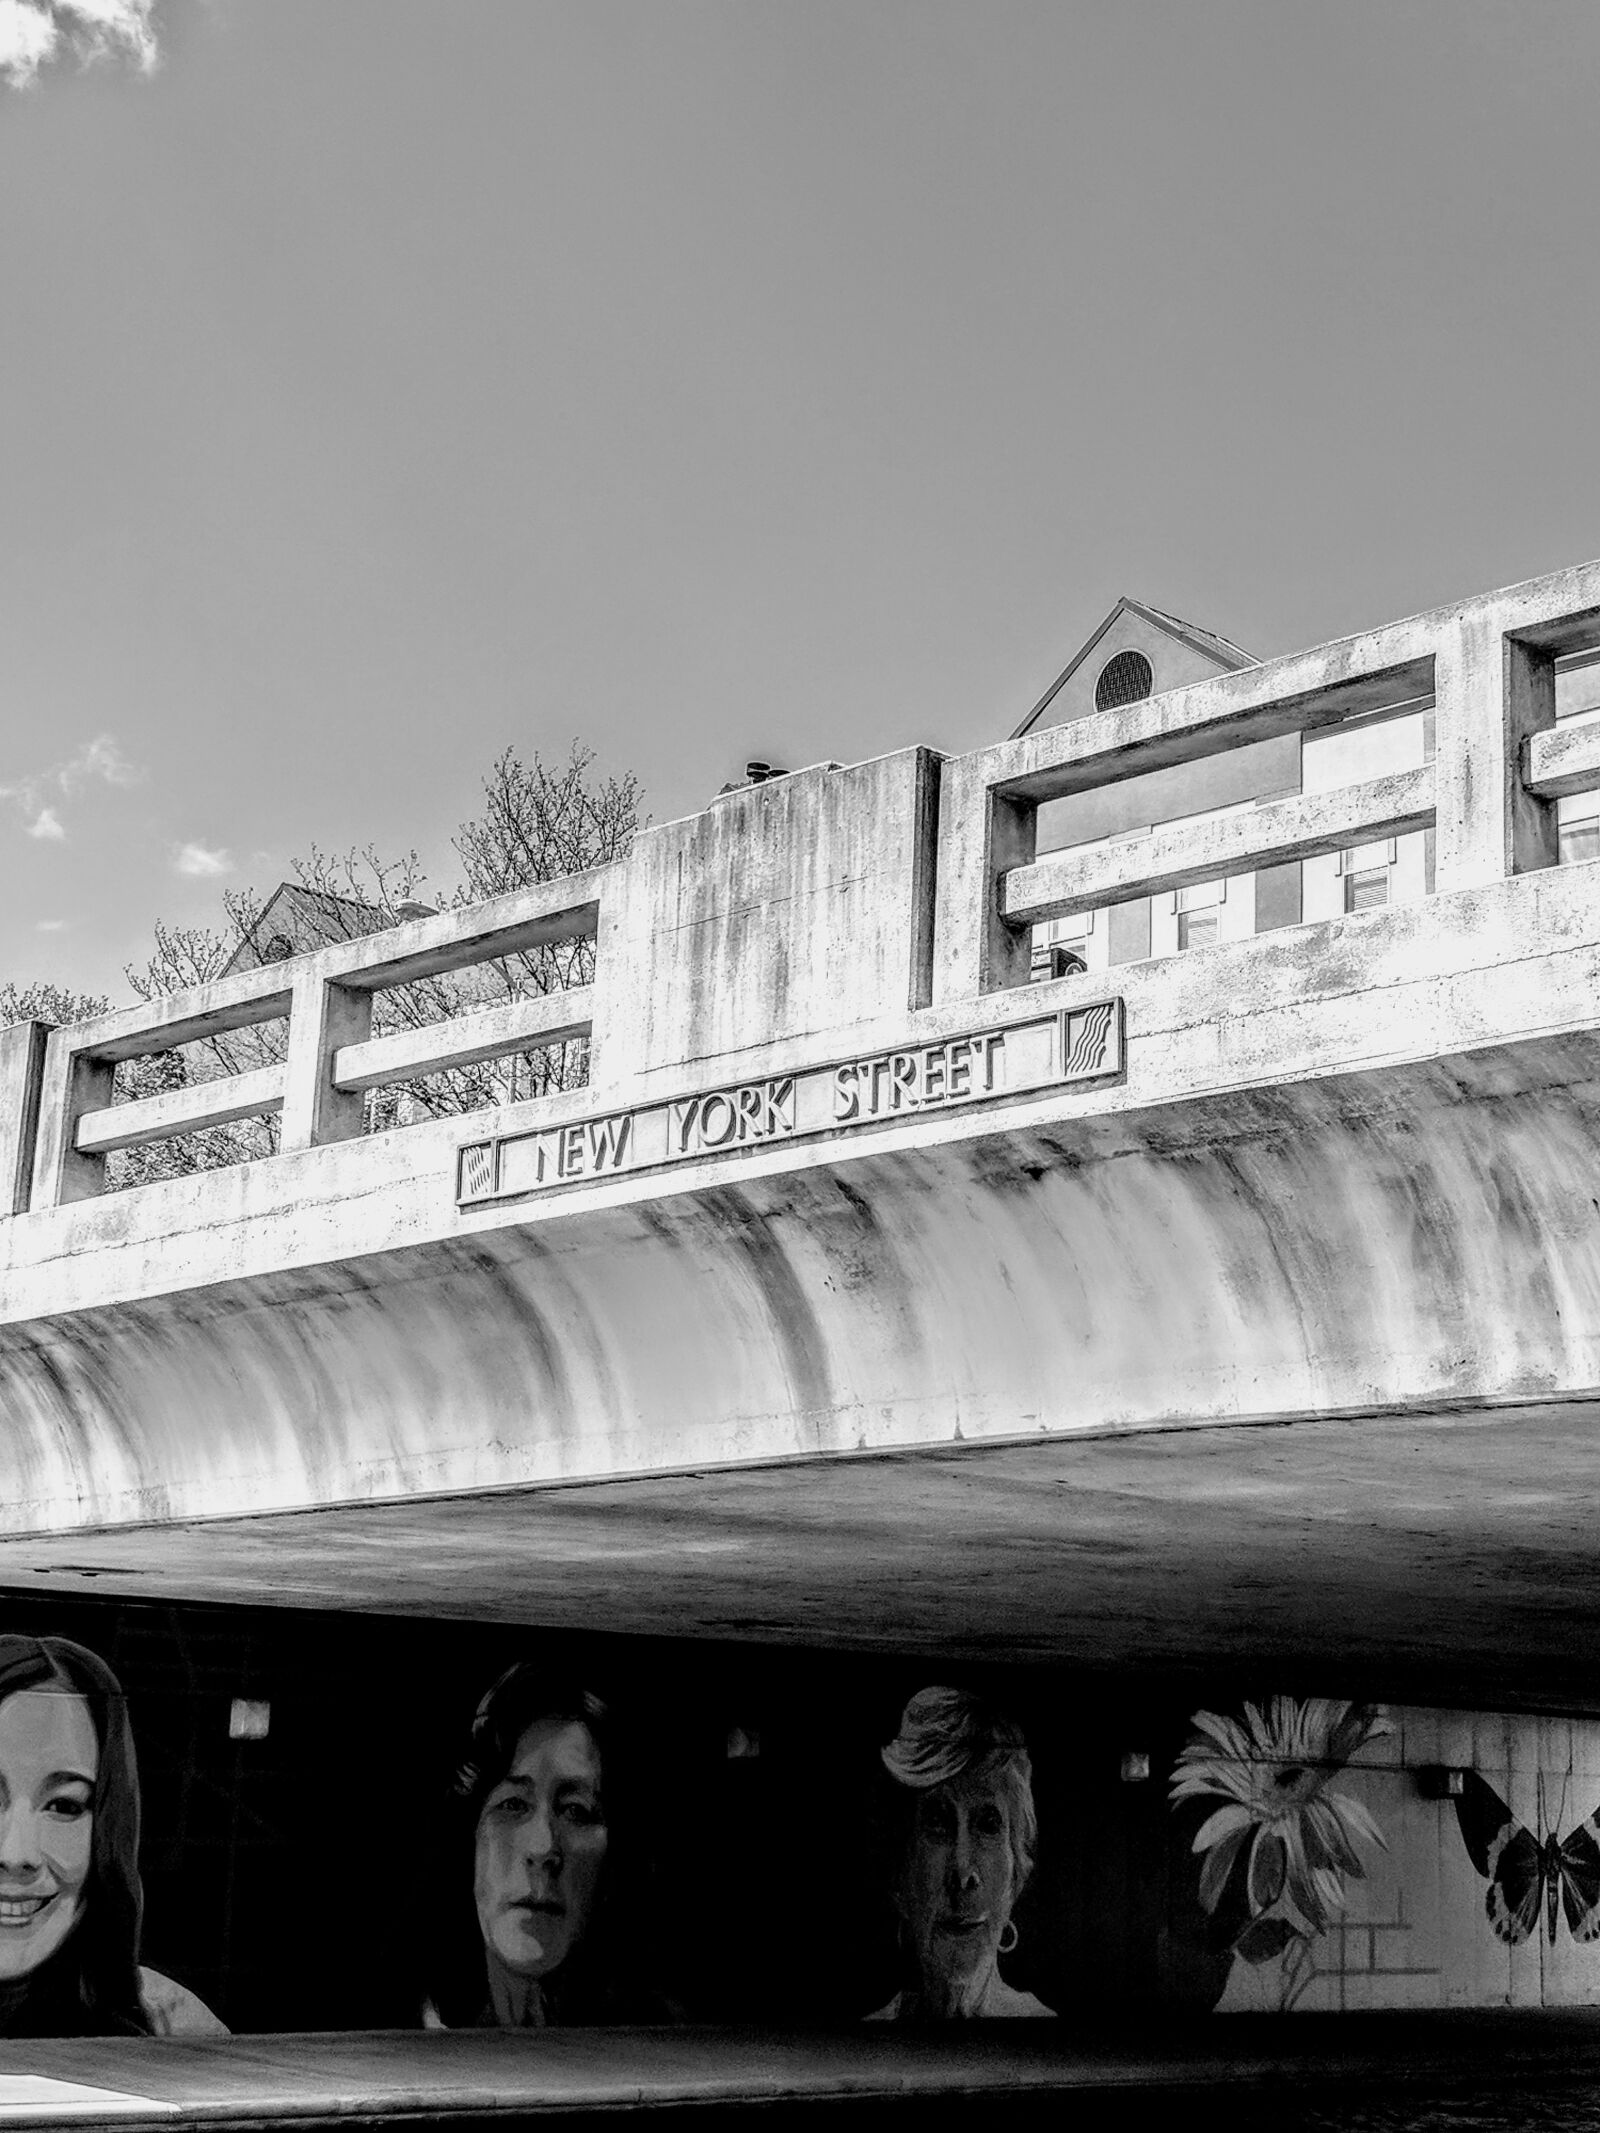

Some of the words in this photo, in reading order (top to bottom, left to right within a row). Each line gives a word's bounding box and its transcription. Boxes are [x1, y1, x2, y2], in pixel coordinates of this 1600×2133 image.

[534, 1114, 631, 1182] NEW
[668, 1078, 796, 1152] YORK
[833, 1032, 1005, 1121] STREET
